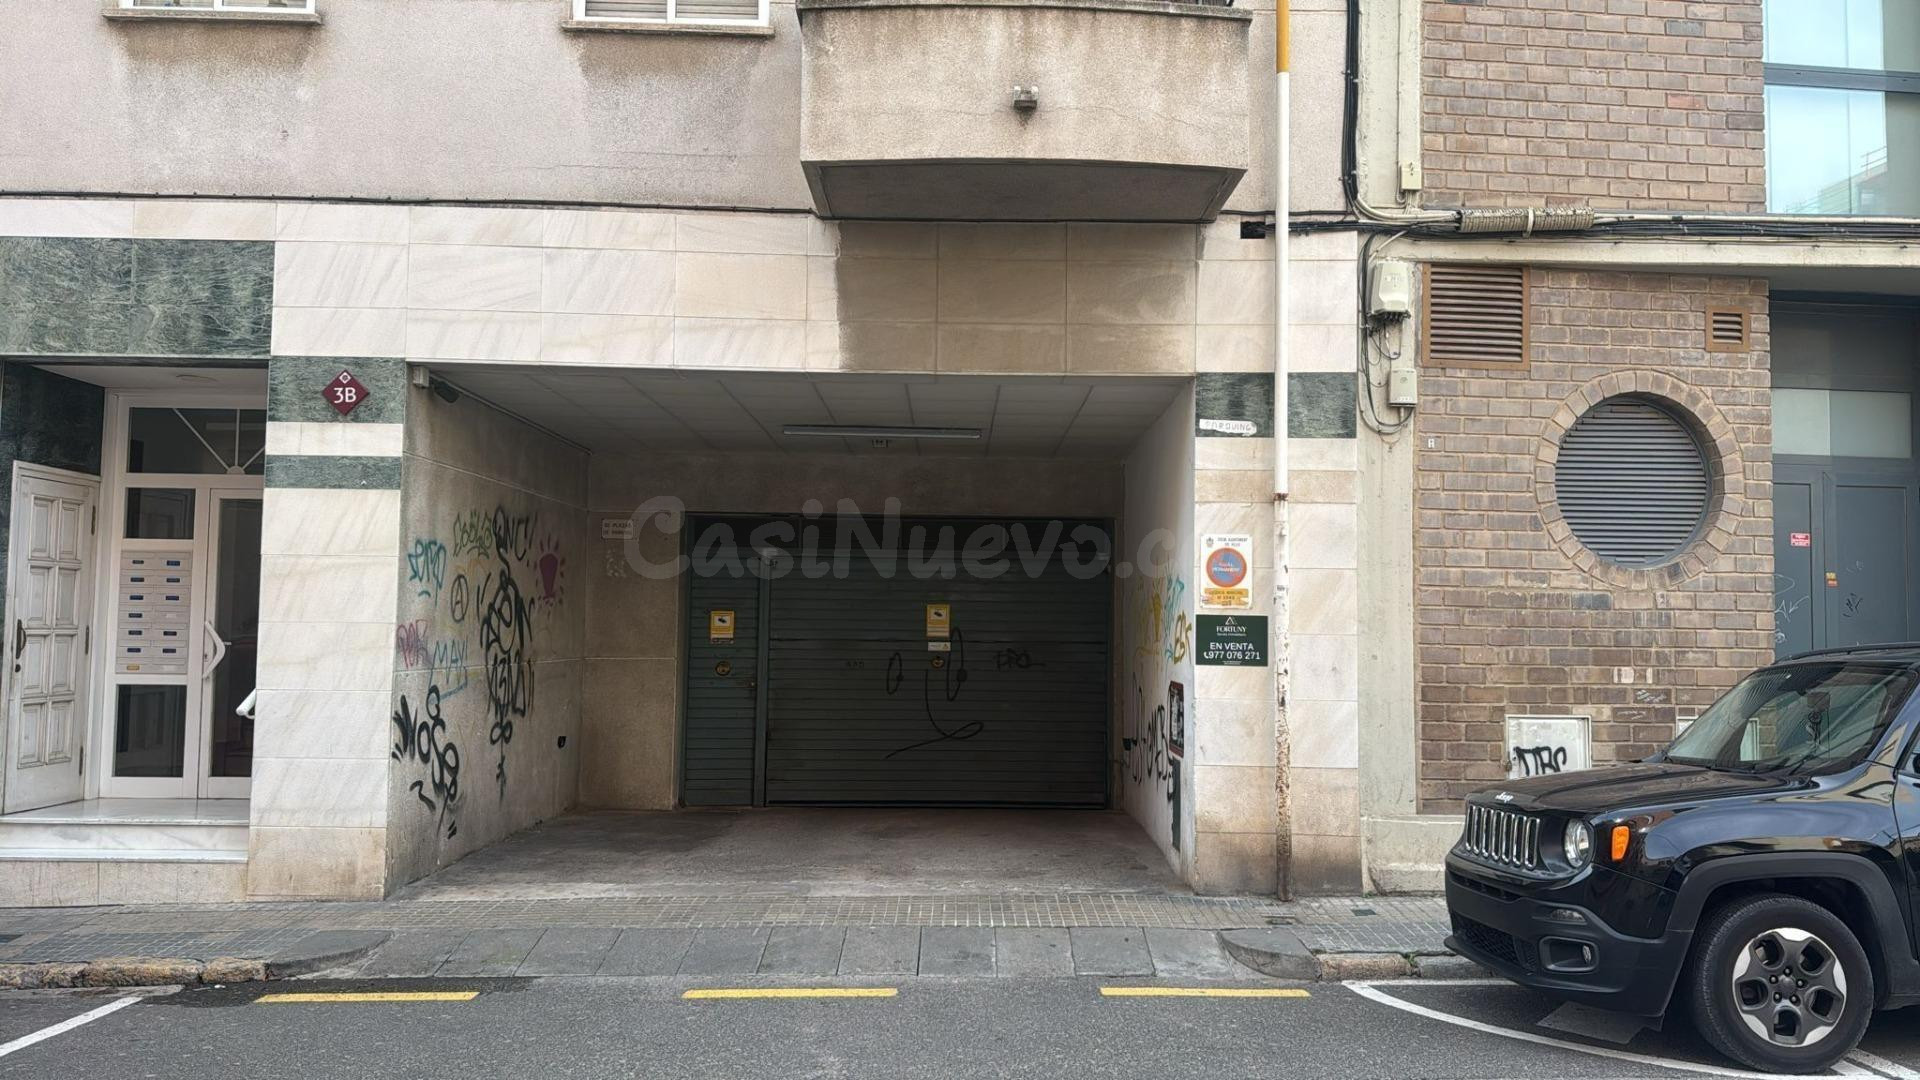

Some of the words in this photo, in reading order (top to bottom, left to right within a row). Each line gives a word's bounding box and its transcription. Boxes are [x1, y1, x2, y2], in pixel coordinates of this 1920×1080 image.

[333, 387, 357, 404] 3B
[1216, 625, 1247, 633] FORTUNY
[1210, 642, 1223, 650] EN
[1224, 642, 1254, 651] VENTA
[1208, 651, 1225, 660] 977
[1226, 651, 1243, 660] 076
[1245, 651, 1261, 660] 271
